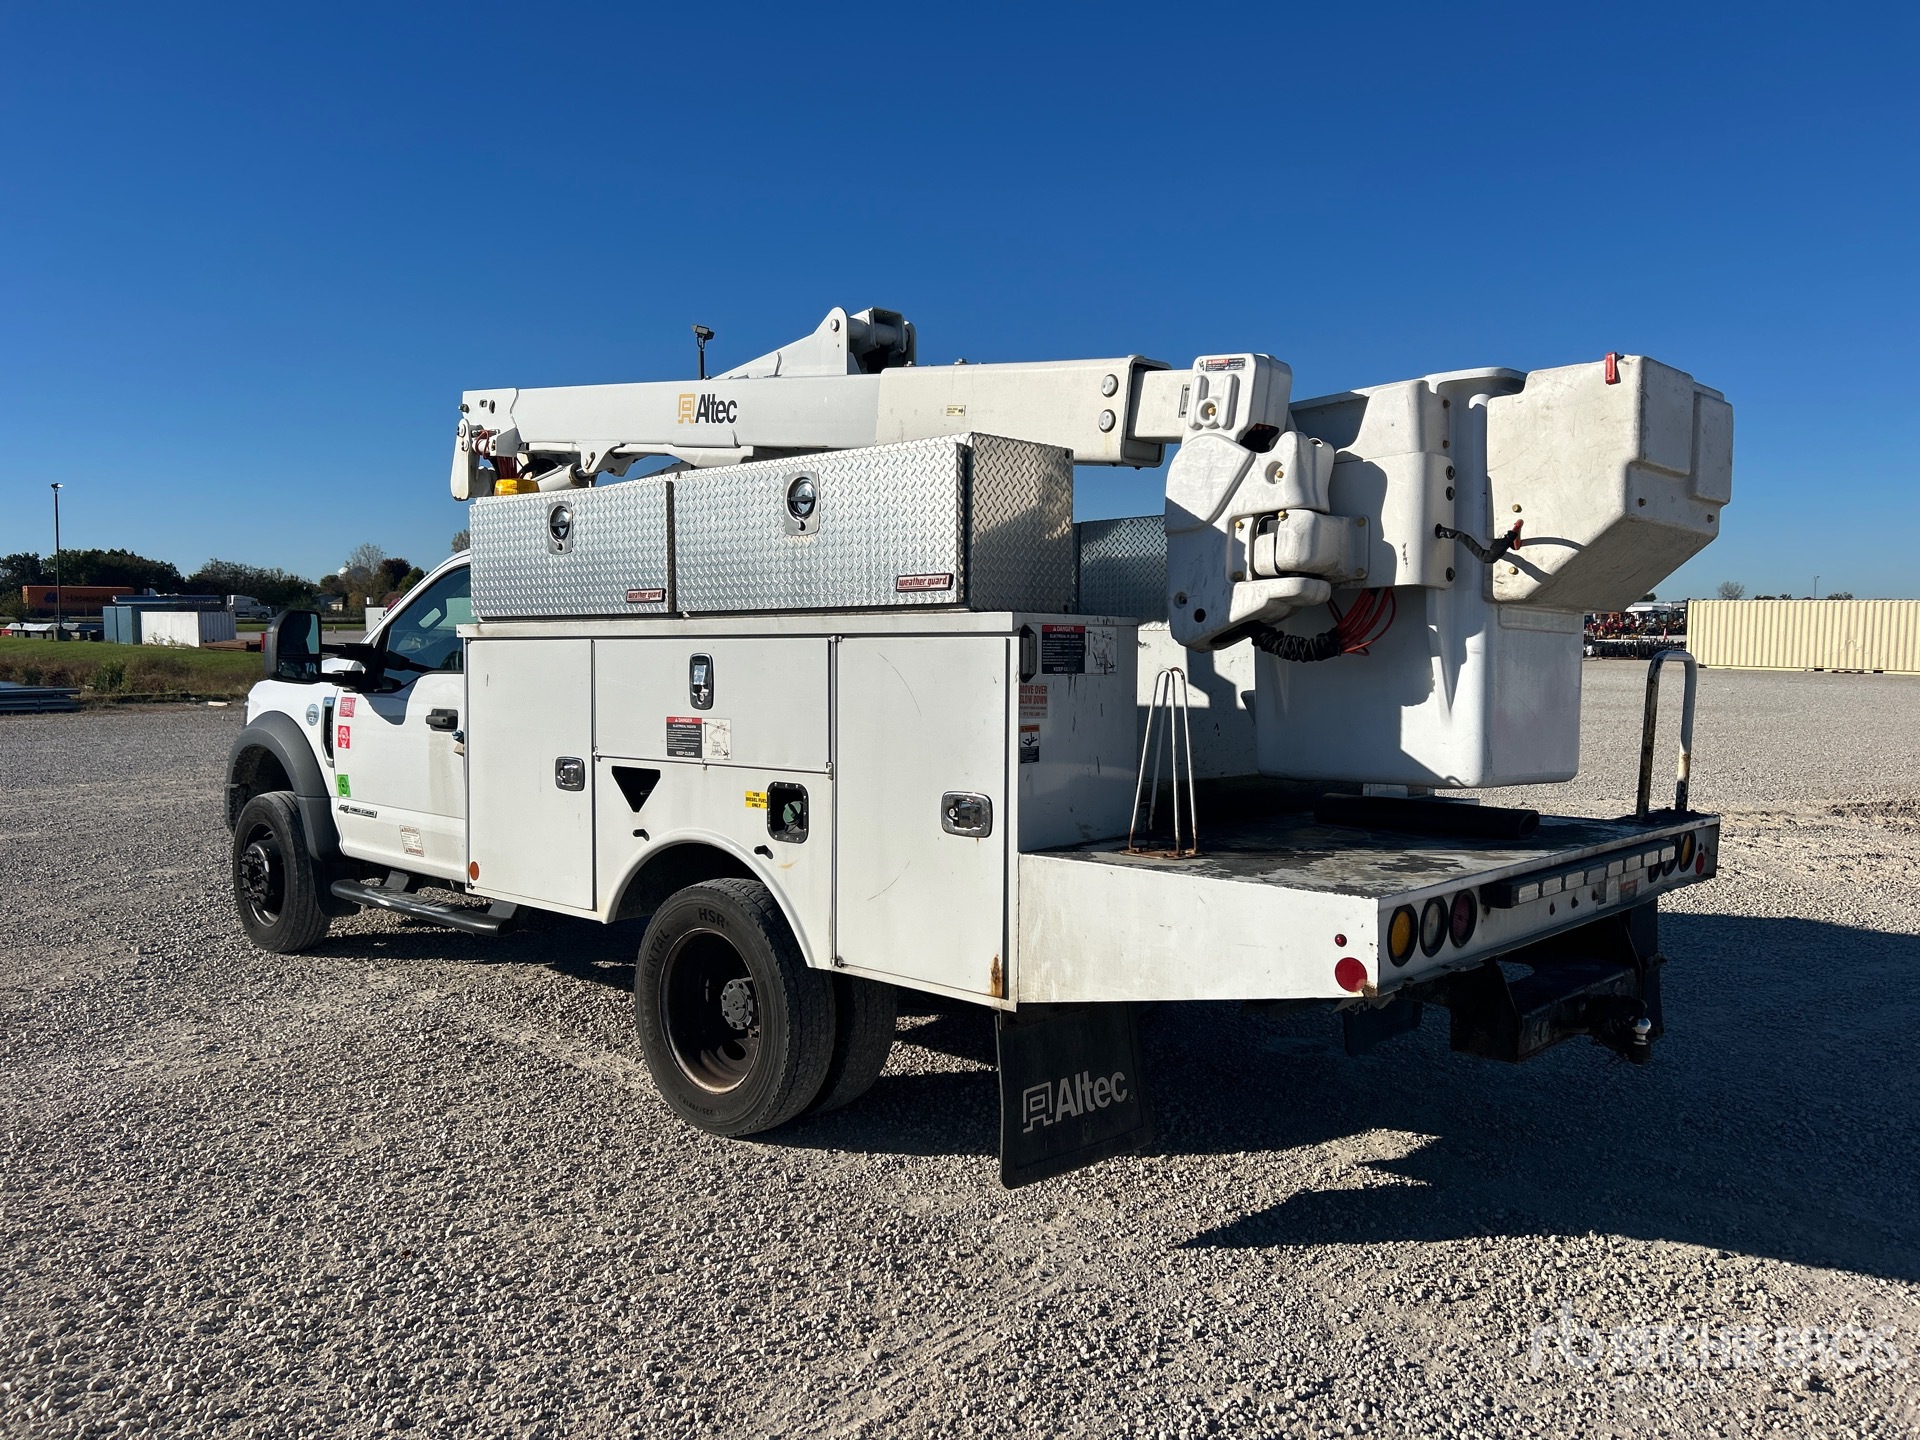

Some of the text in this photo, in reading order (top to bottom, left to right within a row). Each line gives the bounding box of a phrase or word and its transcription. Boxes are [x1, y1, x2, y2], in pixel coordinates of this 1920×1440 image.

[695, 394, 737, 423] Altec
[899, 576, 947, 586] weather guard
[1055, 1070, 1127, 1122] Altec
